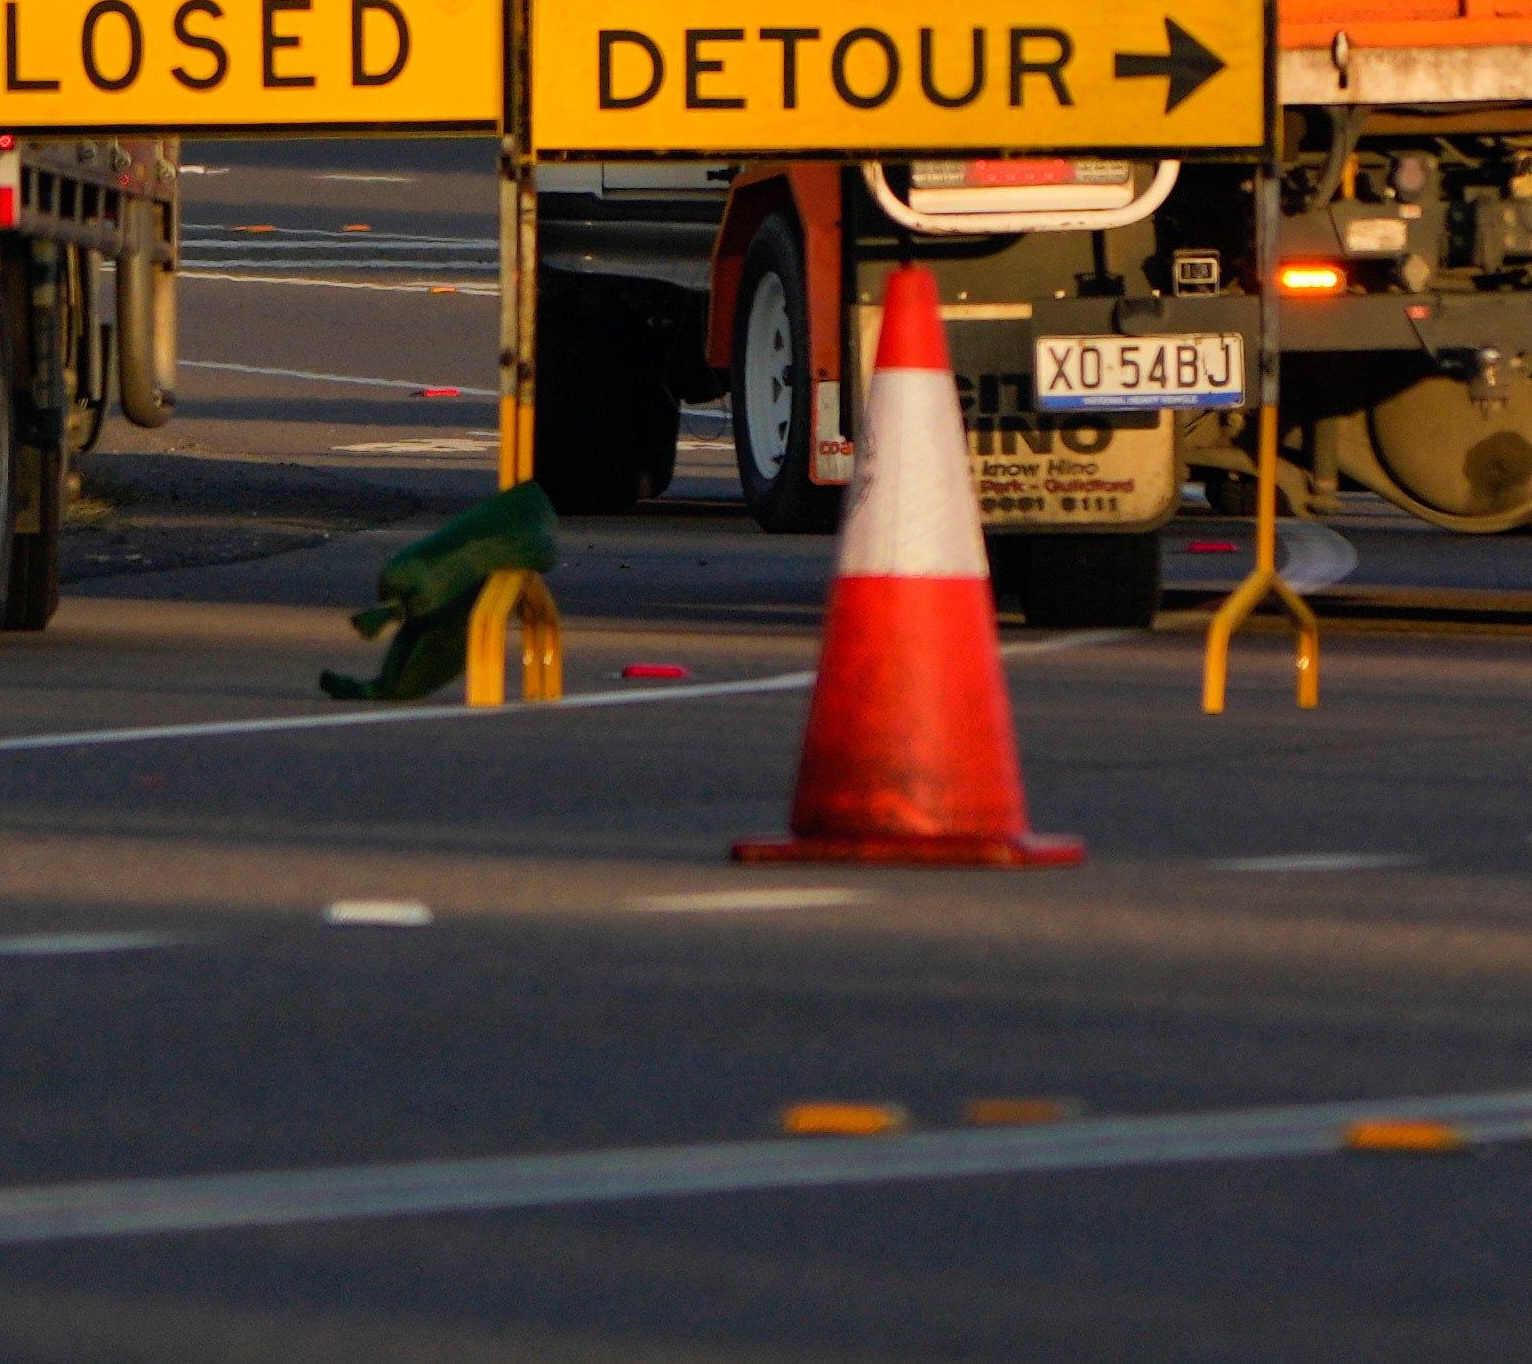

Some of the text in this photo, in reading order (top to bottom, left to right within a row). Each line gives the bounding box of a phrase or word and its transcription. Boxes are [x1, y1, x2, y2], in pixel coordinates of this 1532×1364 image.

[598, 26, 1075, 111] DETOUR
[982, 459, 1100, 477] know Hino
